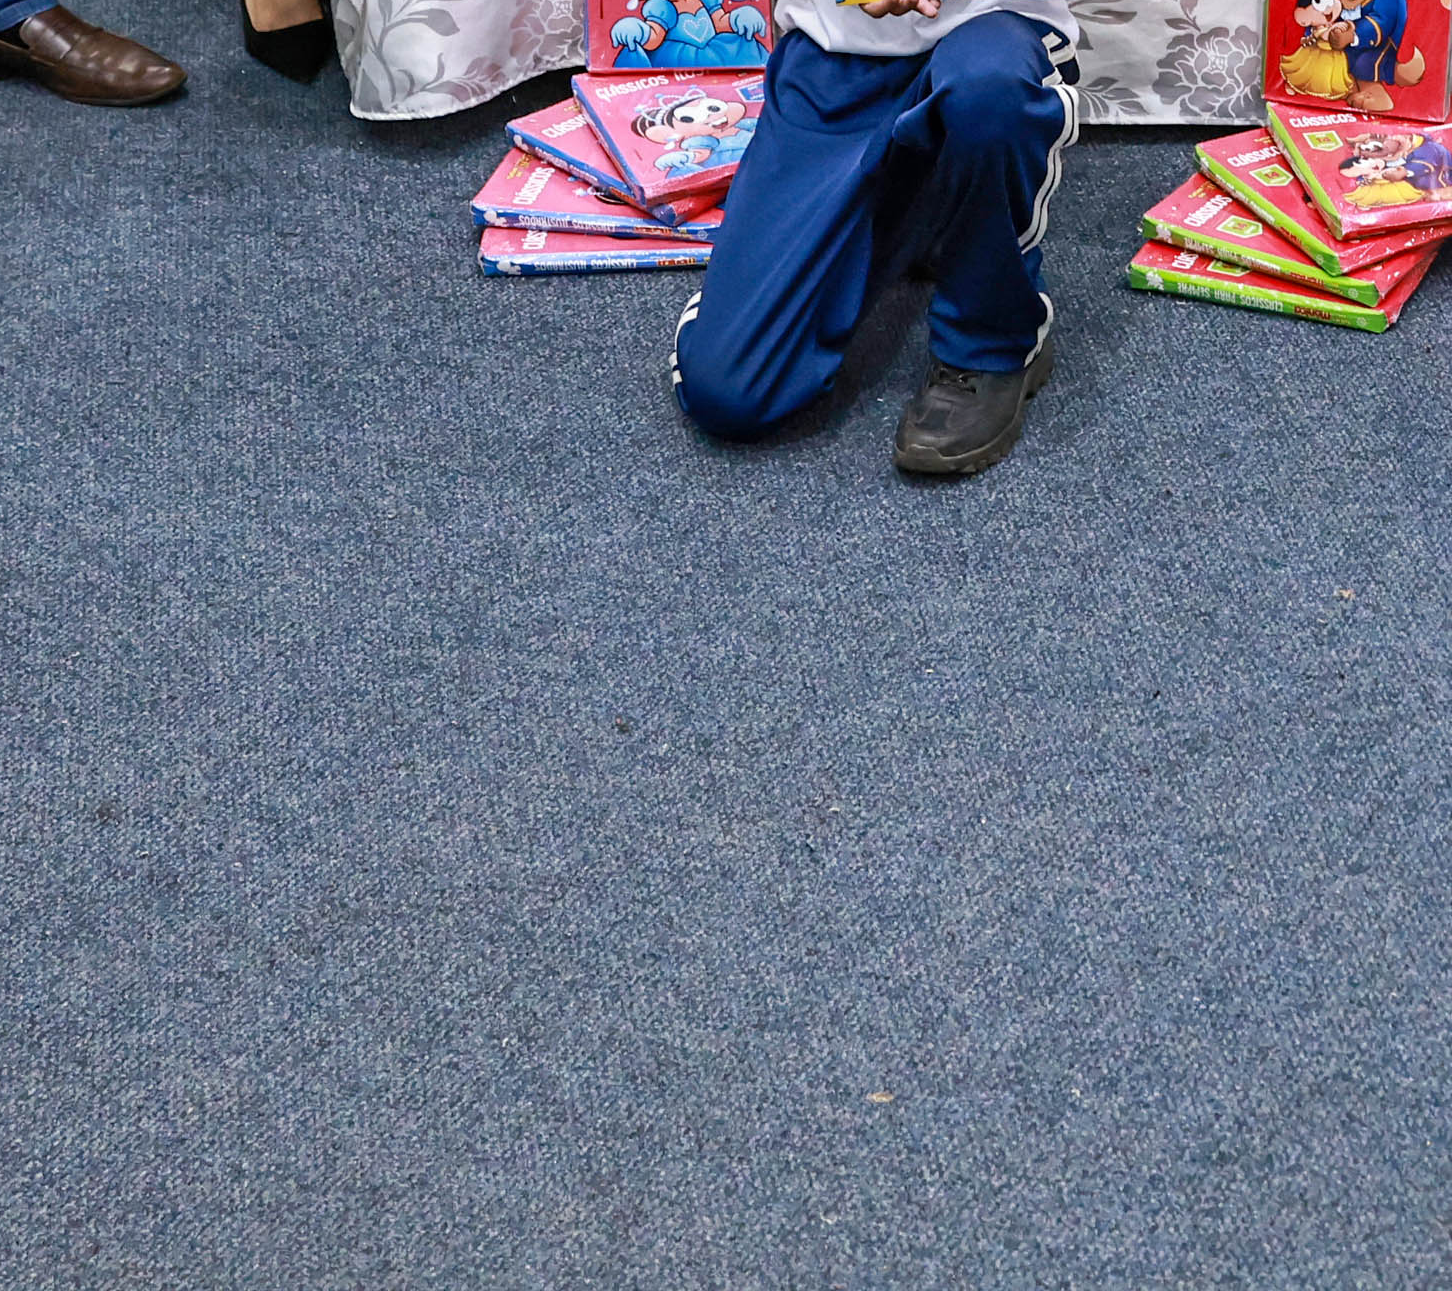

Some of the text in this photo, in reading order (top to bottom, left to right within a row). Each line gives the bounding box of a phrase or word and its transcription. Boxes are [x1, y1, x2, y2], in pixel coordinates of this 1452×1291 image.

[542, 114, 588, 139] CLÁSSI
[1228, 146, 1281, 167] CLÁSSICO
[1184, 195, 1232, 227] CLÁSSICOS
[1178, 282, 1210, 299] SEMPRE
[1214, 290, 1237, 304] PARA
